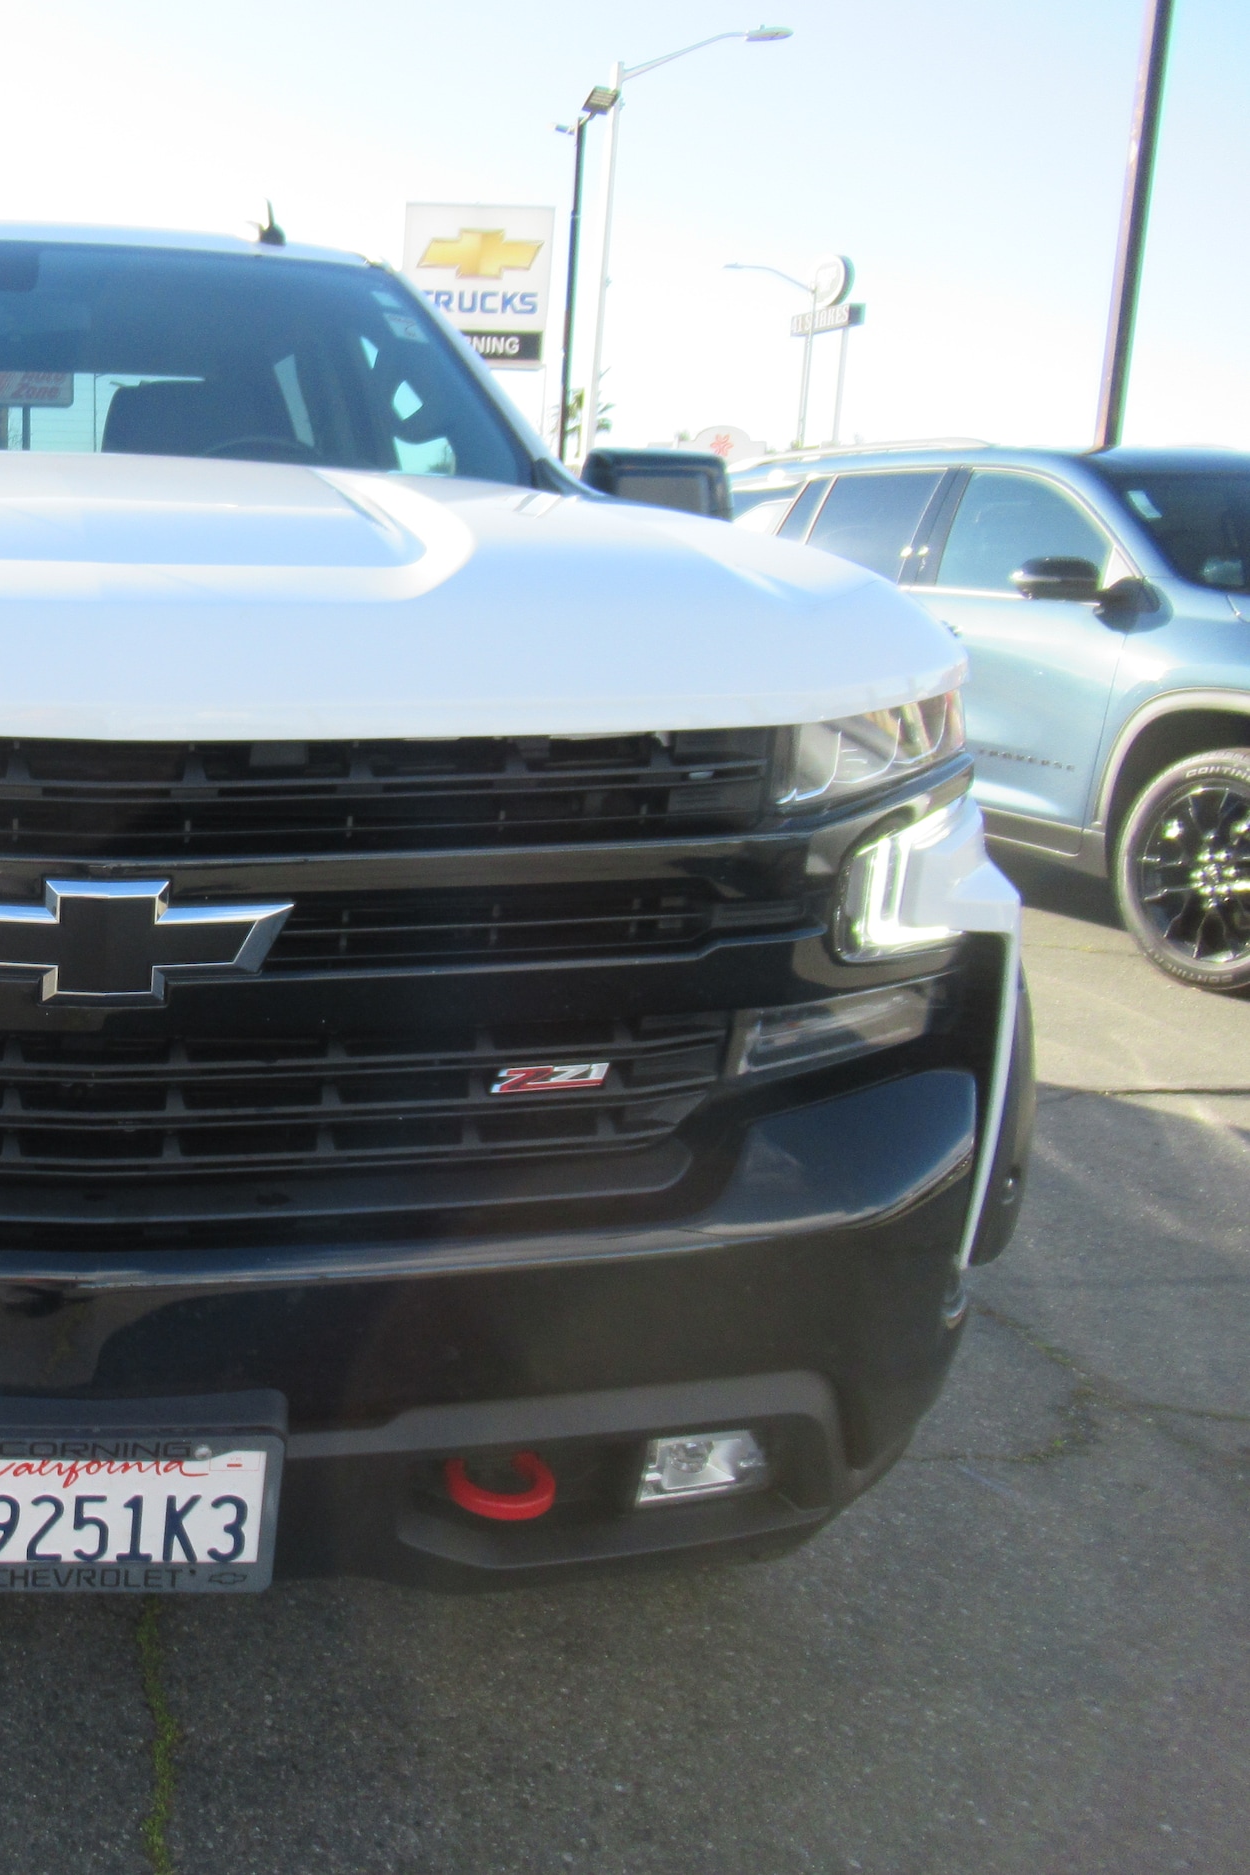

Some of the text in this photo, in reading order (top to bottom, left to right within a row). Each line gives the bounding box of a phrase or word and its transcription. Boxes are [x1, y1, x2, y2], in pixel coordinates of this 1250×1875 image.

[464, 335, 520, 355] NING
[11, 383, 61, 400] Zone
[490, 1062, 610, 1093] Z71
